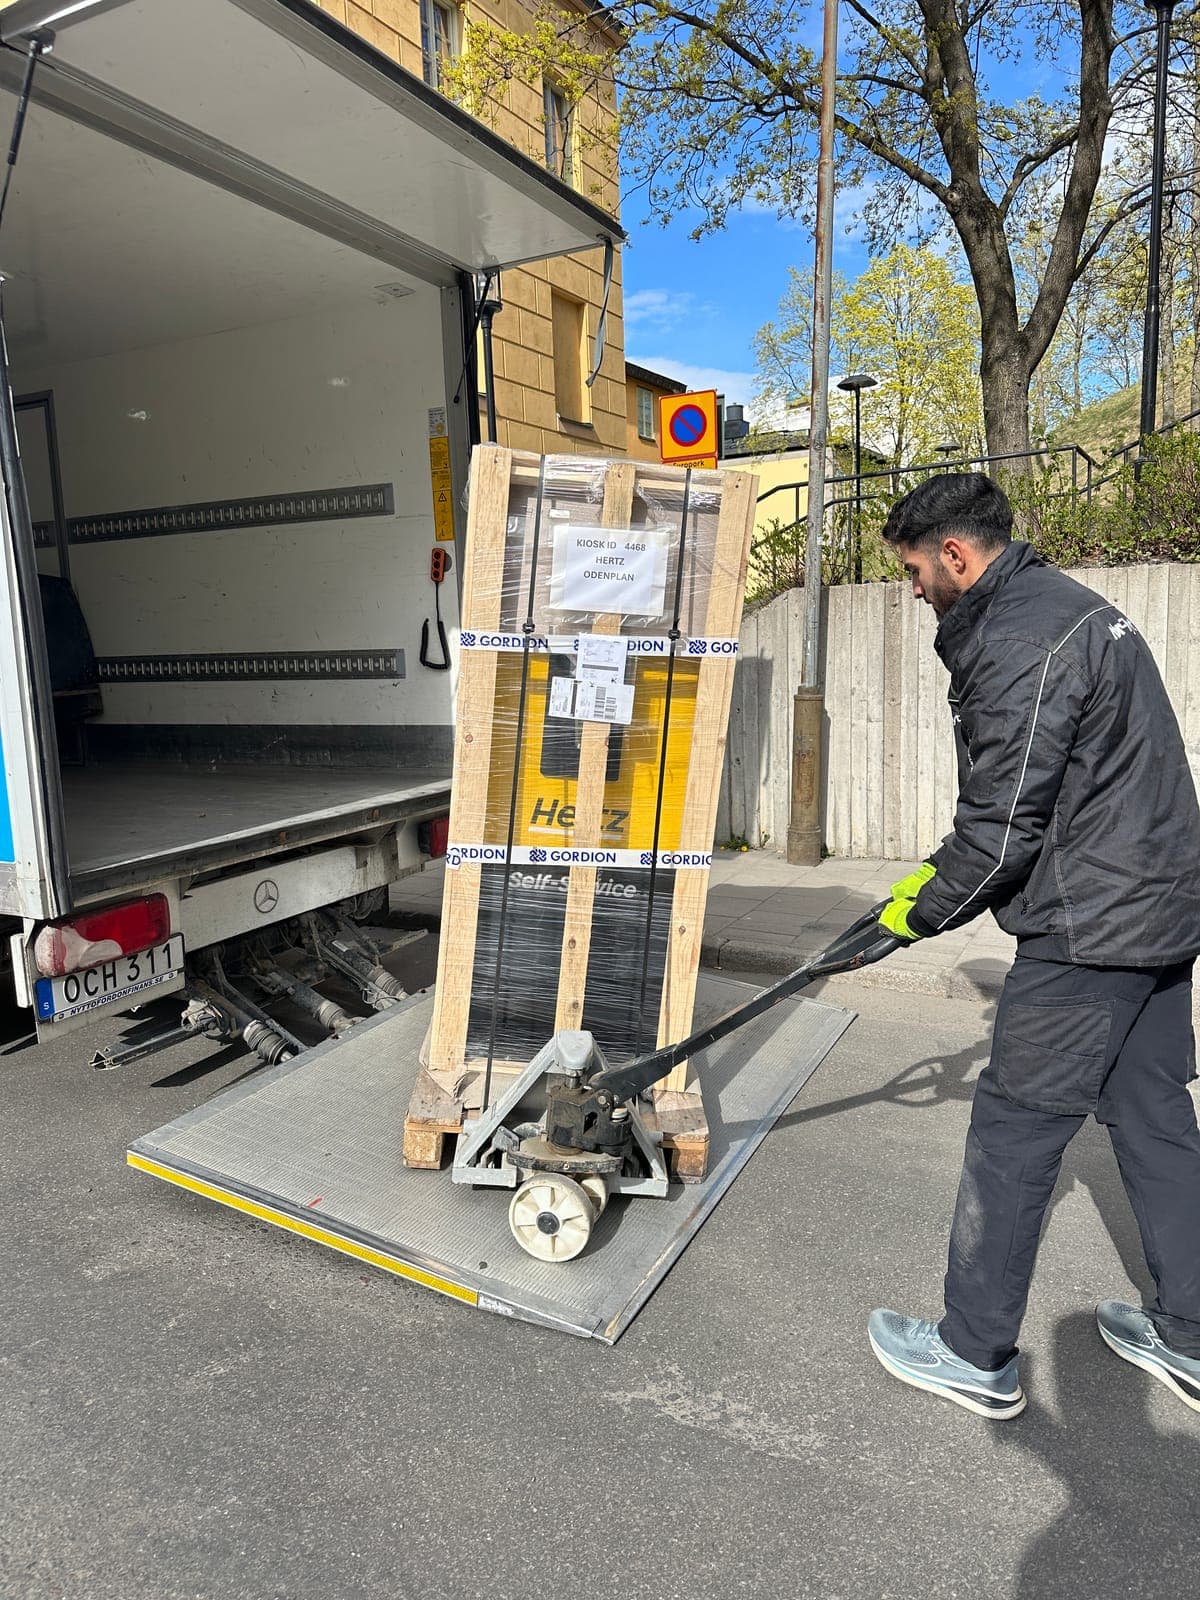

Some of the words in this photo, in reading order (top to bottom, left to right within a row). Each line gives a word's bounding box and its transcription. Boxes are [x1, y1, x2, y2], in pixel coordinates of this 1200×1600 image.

[576, 538, 605, 549] KIOSK
[607, 541, 617, 549] ID
[624, 542, 646, 552] 4468
[595, 556, 625, 566] HERTZ
[583, 570, 635, 582] ODENPLAN
[480, 635, 548, 649] GORDION
[627, 639, 664, 652] DION
[550, 850, 616, 864] GORDION
[508, 871, 638, 898] Self-Svice
[63, 961, 117, 1004] OCH
[127, 943, 173, 982] 311
[70, 976, 164, 1016] NYTTOFORDONFINANS.SE
[43, 1001, 50, 1011] S
